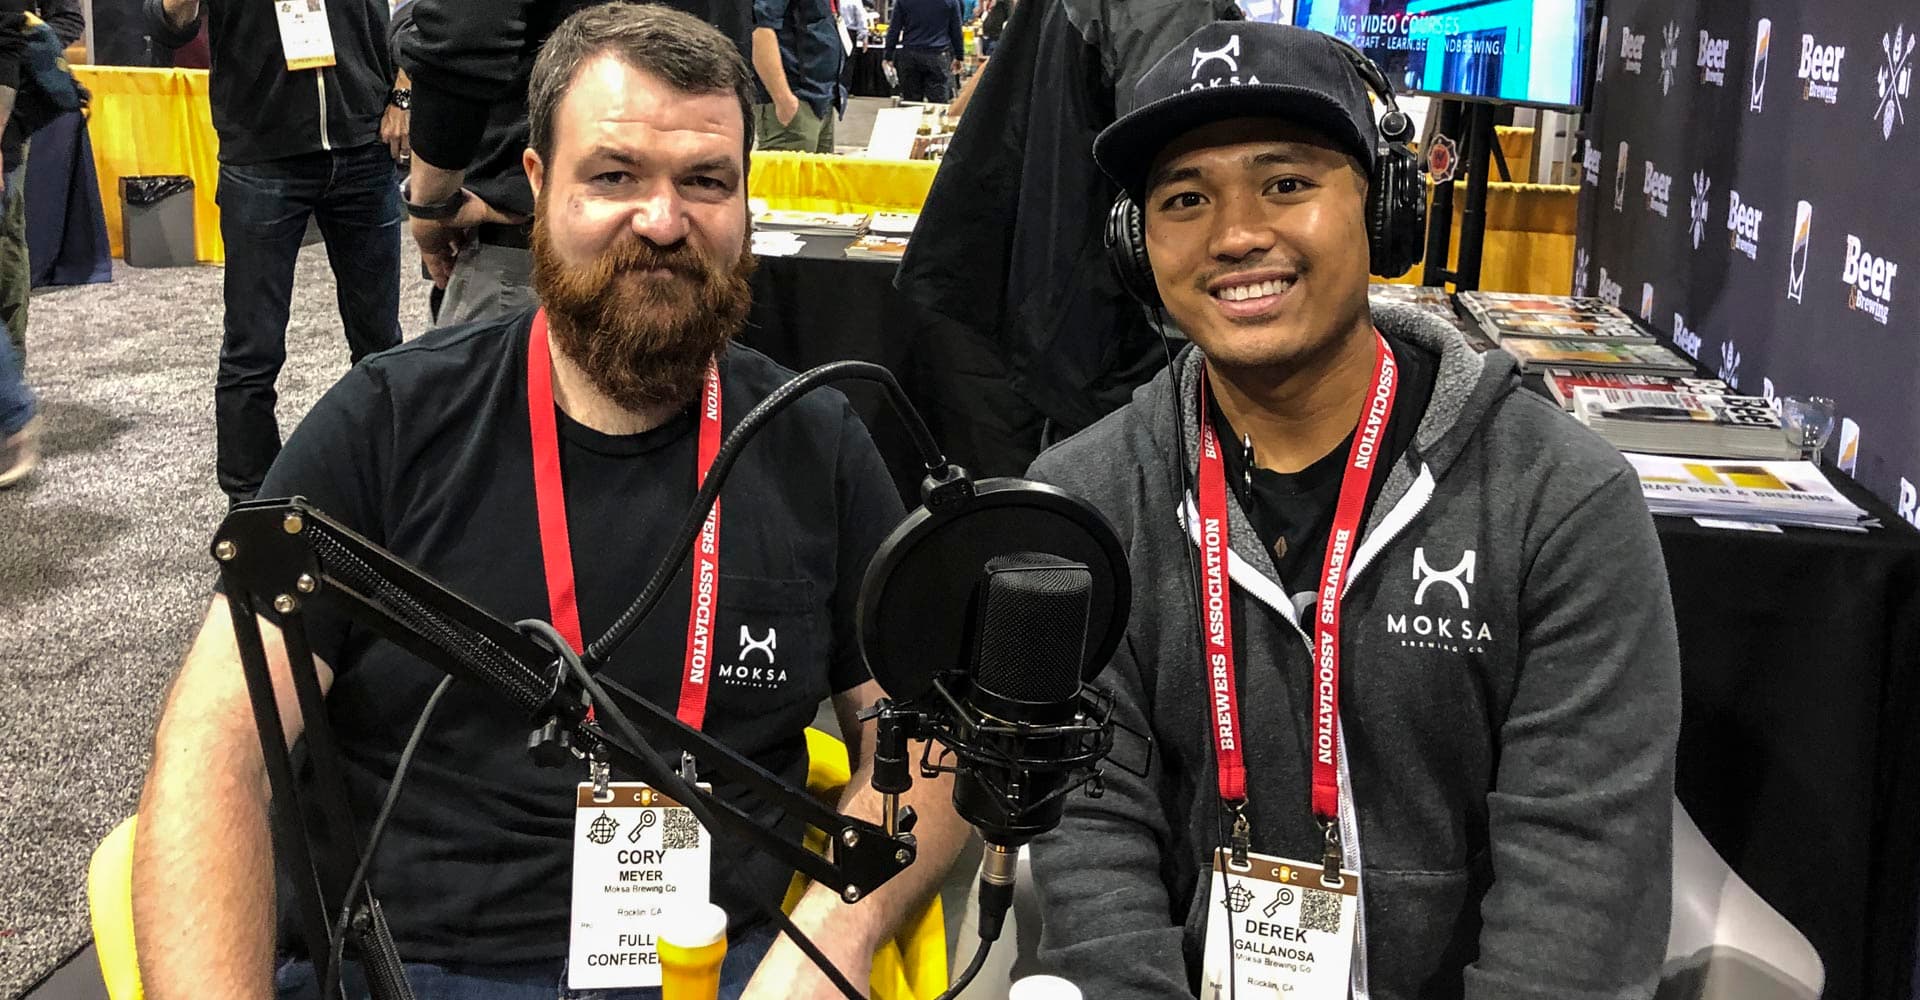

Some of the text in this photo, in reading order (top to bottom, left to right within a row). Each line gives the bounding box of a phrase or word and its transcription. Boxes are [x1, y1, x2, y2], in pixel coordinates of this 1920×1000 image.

[1335, 15, 1460, 36] ING VIDEO COURSES
[1356, 35, 1379, 48] CRAFT
[1697, 30, 1729, 69] Beer
[1798, 33, 1845, 82] Beer
[1727, 190, 1762, 241] Beer
[1842, 234, 1898, 301] Beer
[1855, 289, 1889, 325] Brewing
[1354, 353, 1395, 470] ASSOCIATION
[1642, 483, 1683, 494] RAFT
[1688, 486, 1731, 496] BEER
[1754, 490, 1834, 503] BREWING
[689, 559, 714, 685] ASSOCIATION
[1387, 613, 1492, 641] MOKSA
[1205, 518, 1235, 751] BREWERS ASSOCIATION
[1318, 528, 1350, 765] BREWERS ASSOCIATION
[718, 663, 787, 682] MOKSA
[617, 849, 666, 865] CORY
[619, 870, 663, 881] MEYER
[632, 884, 664, 895] Brewing
[665, 884, 677, 893] Co
[619, 934, 655, 947] FULL
[1245, 919, 1308, 943] DEREK
[587, 953, 660, 967] CONFERE
[1234, 939, 1315, 963] GALLANOSA
[1264, 955, 1297, 972] Brewing
[1282, 983, 1294, 992] CA
